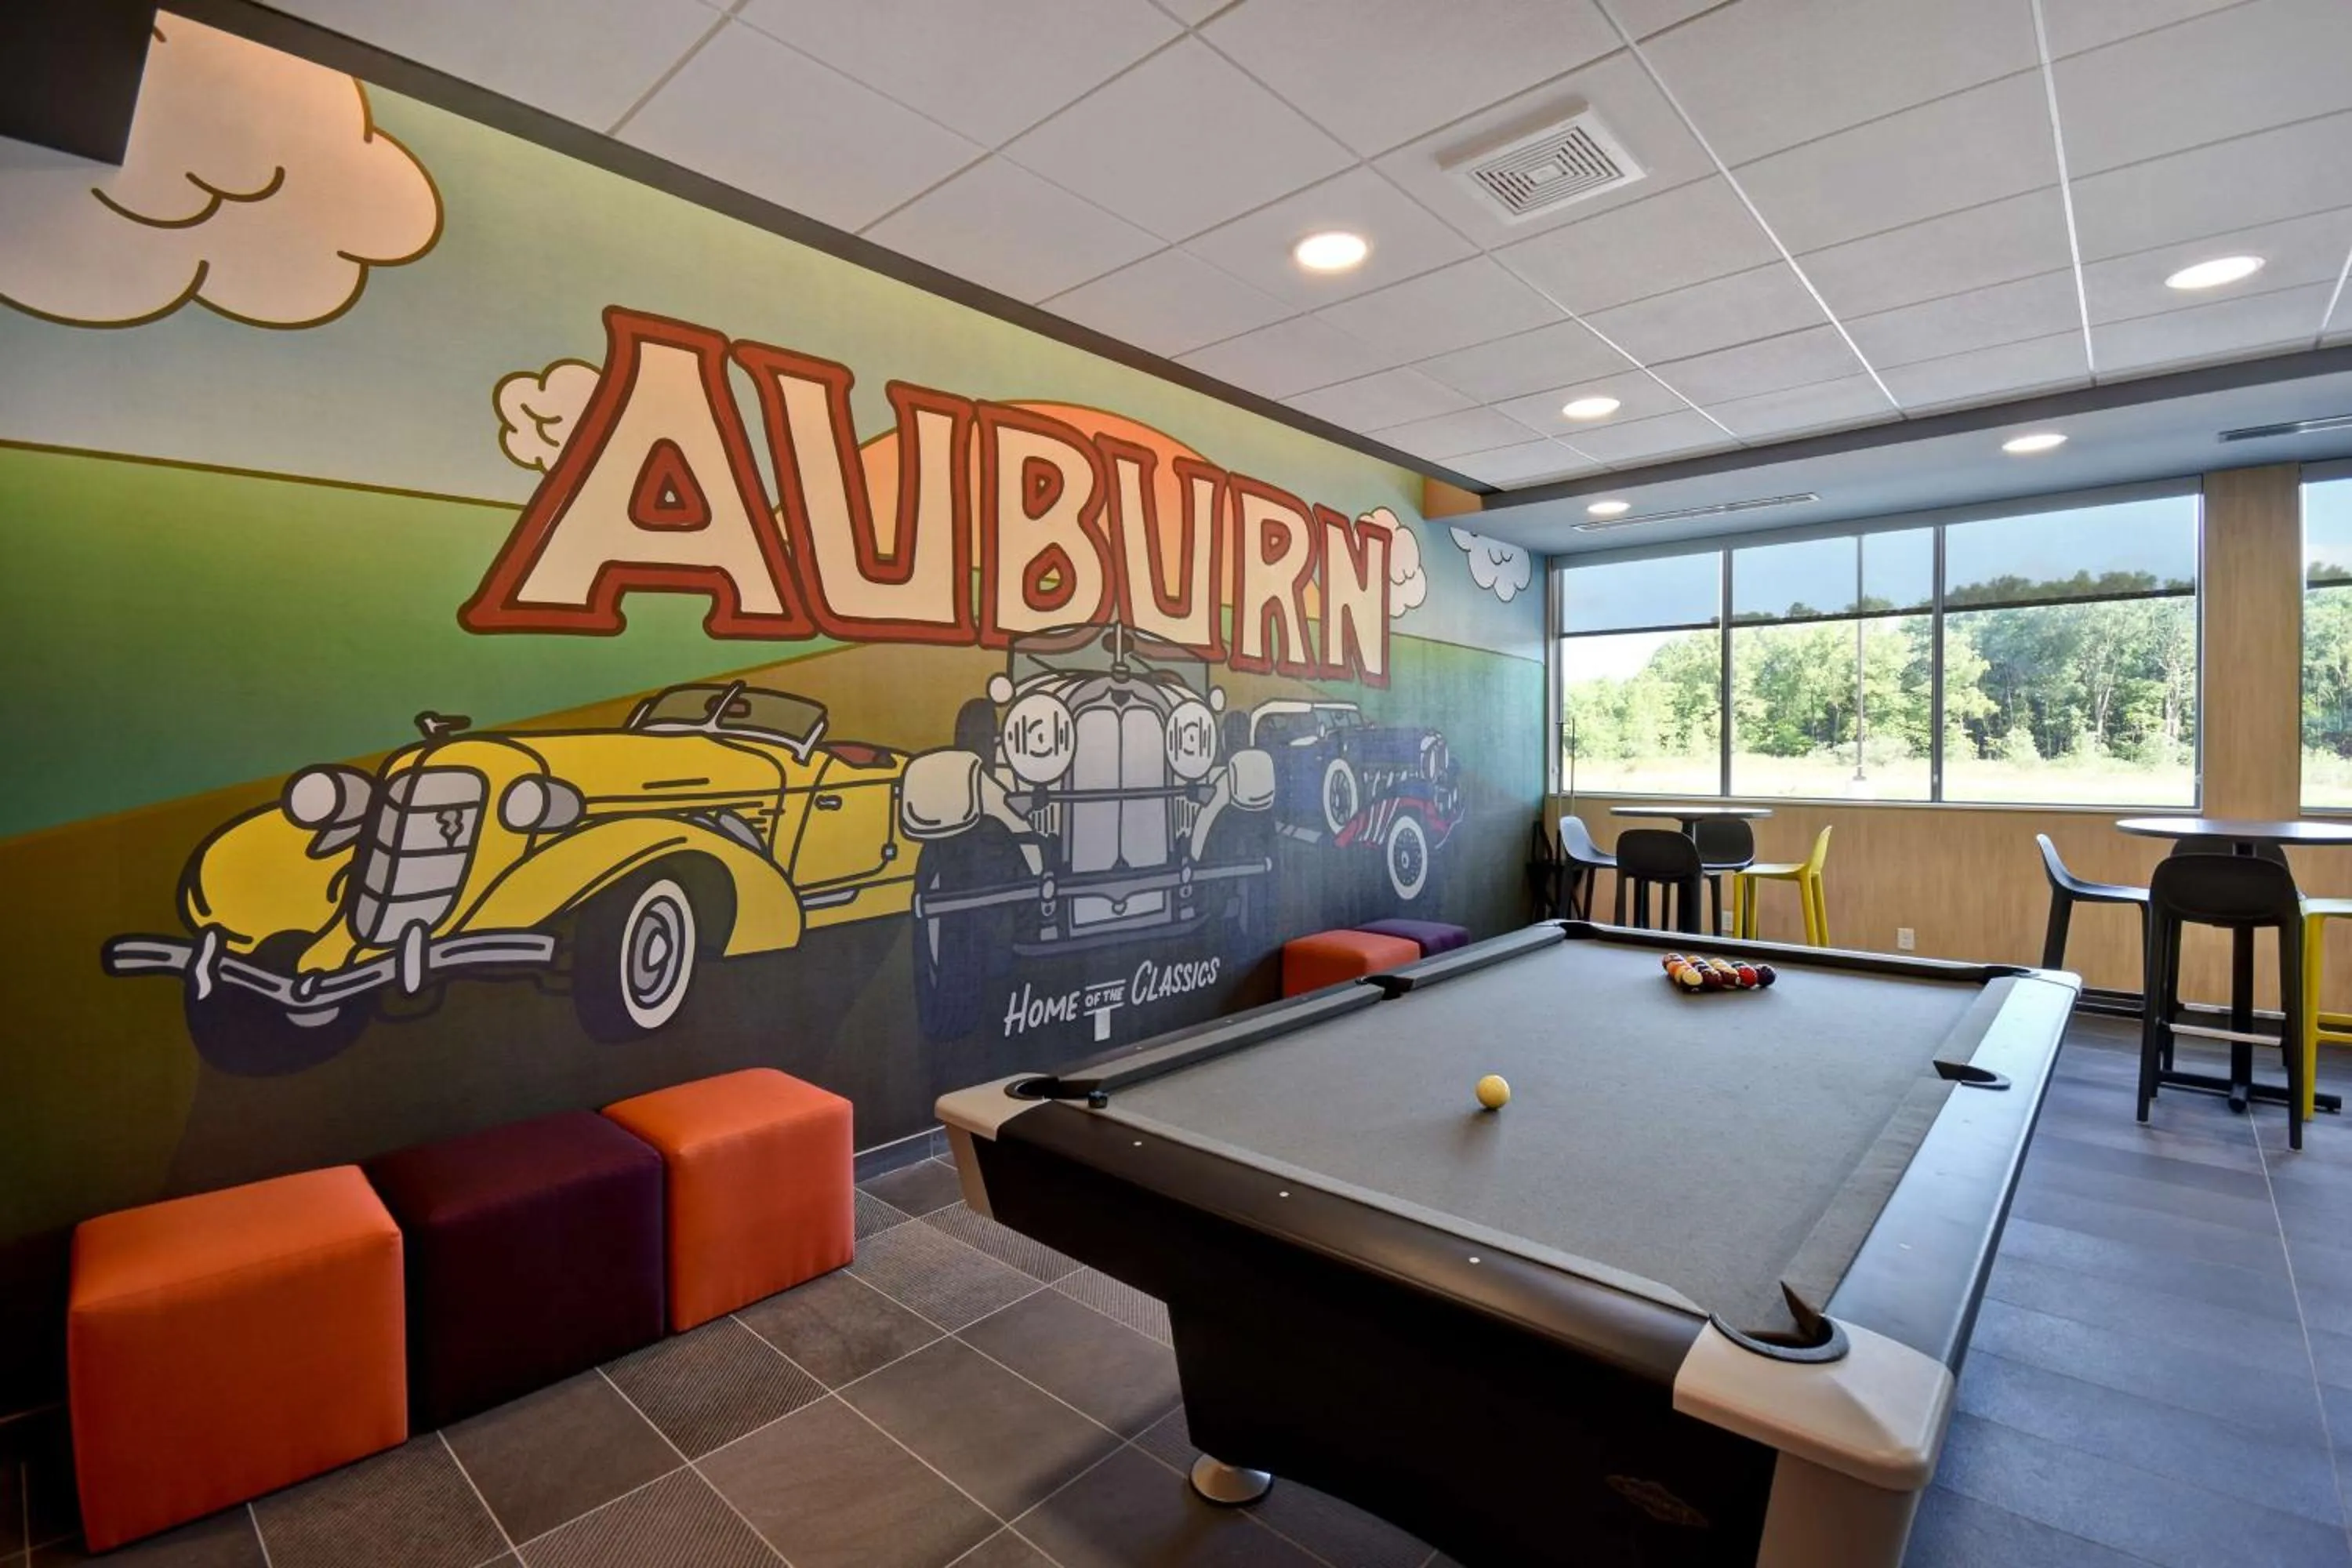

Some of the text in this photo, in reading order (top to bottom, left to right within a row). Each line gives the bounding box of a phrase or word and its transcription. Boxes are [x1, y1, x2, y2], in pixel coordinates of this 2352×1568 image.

[458, 305, 1392, 687] AUBURN
[1004, 956, 1220, 1037] HOME OF THE CLASSICS
